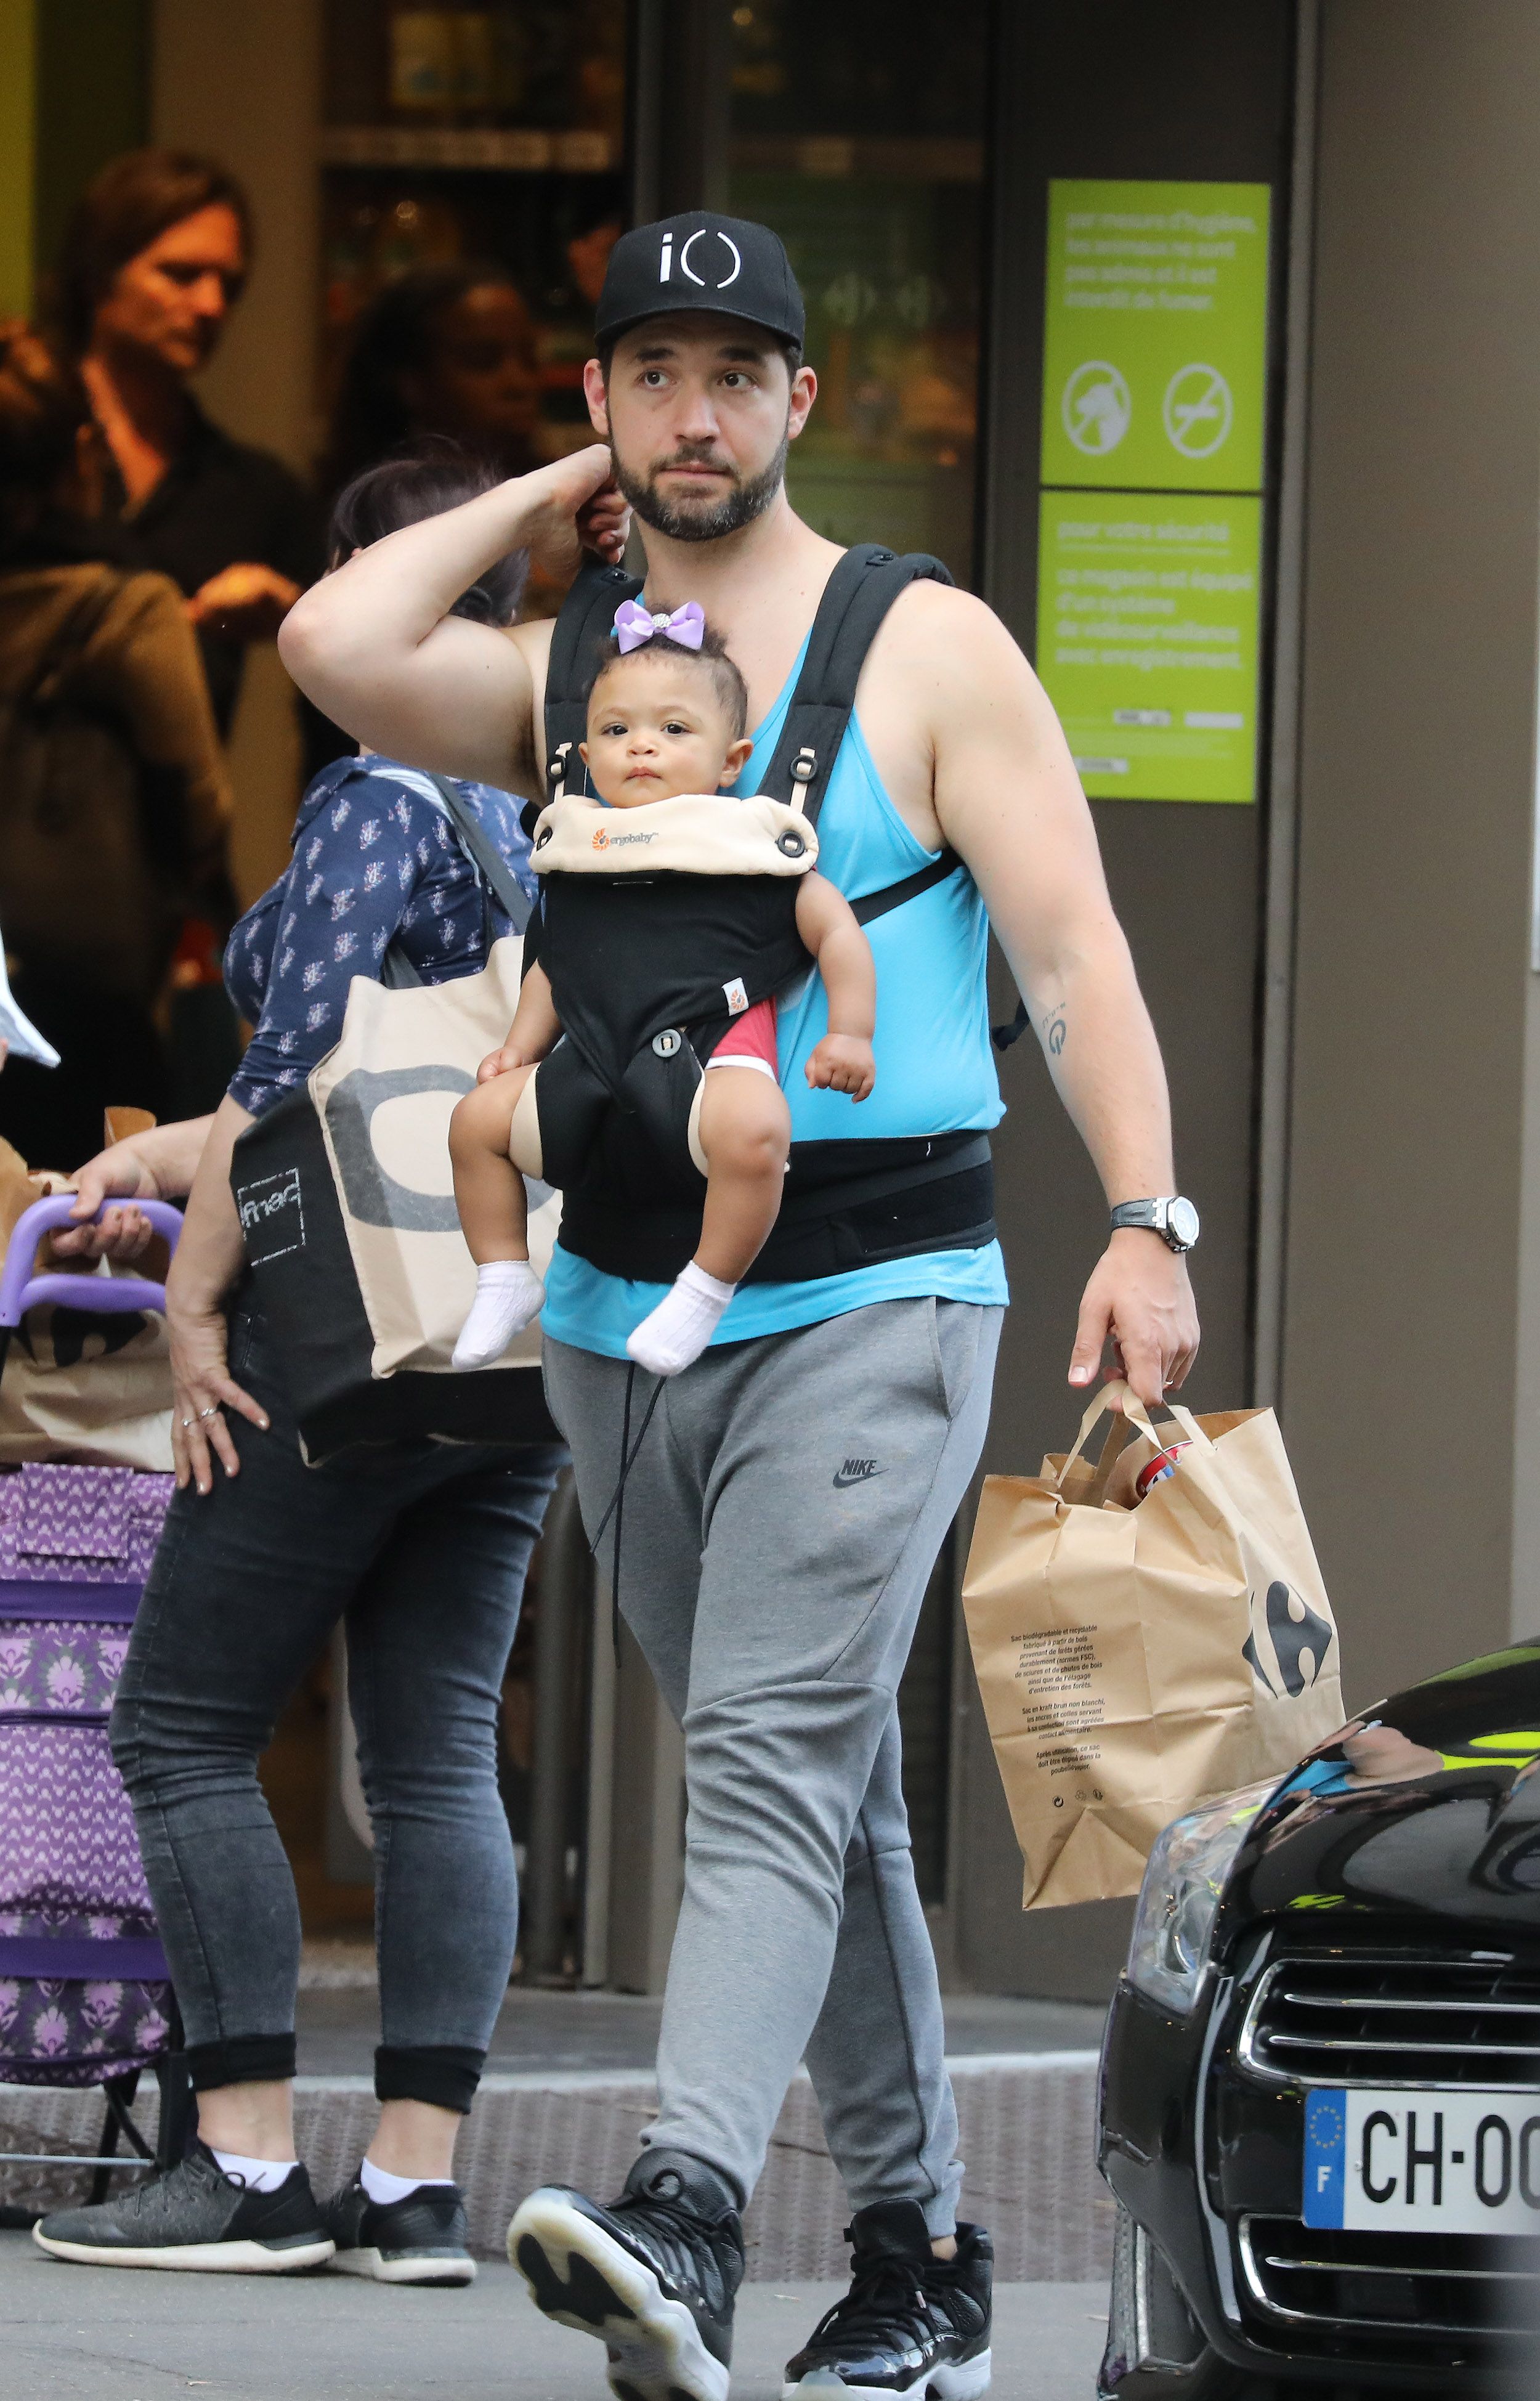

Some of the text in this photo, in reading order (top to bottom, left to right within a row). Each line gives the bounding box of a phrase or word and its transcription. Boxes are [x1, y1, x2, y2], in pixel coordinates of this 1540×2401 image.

[841, 1460, 877, 1475] NIKE
[1023, 1640, 1046, 1649] fabriqué
[1052, 1638, 1066, 1646] partir
[1019, 1650, 1047, 1660] provenant
[1074, 1644, 1093, 1653] gérées
[1019, 1657, 1055, 1668] durablement
[1061, 1665, 1080, 1673] chutes
[1027, 1677, 1041, 1685] ainsi
[1039, 1704, 1053, 1712] kraft
[1038, 1760, 1048, 1768] doit
[1317, 2165, 1332, 2193] F
